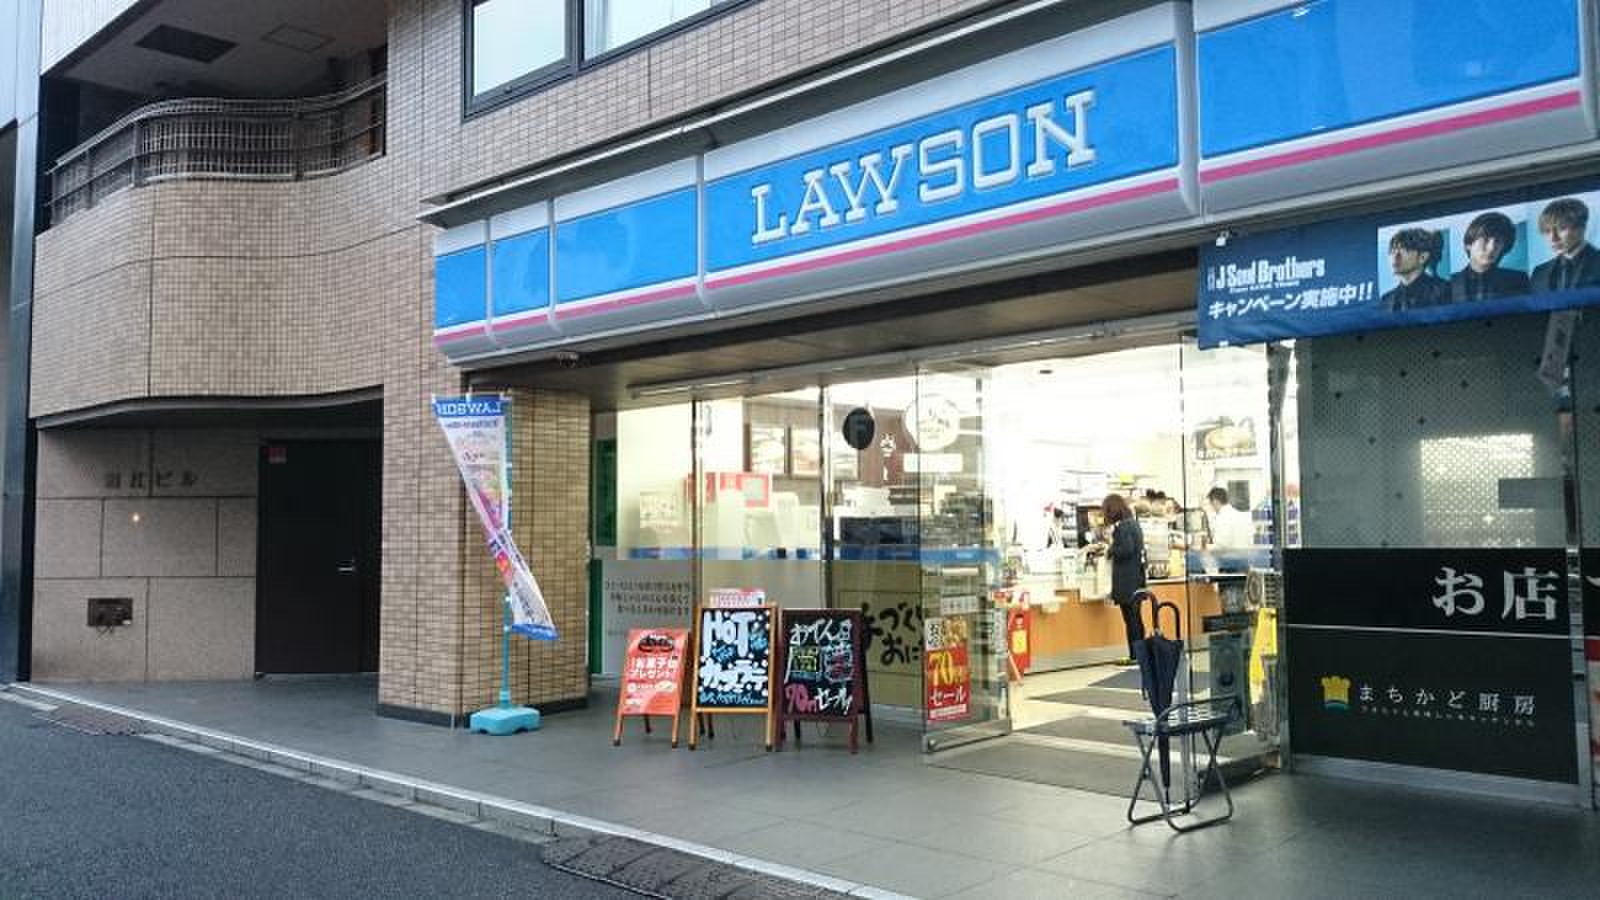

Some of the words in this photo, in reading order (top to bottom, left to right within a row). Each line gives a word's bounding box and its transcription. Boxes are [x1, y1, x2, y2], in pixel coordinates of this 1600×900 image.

[751, 89, 1097, 244] LAWSON
[1227, 260, 1256, 288] Soul
[1258, 256, 1325, 284] Brothers
[1359, 683, 1535, 716] まちかど厨房
